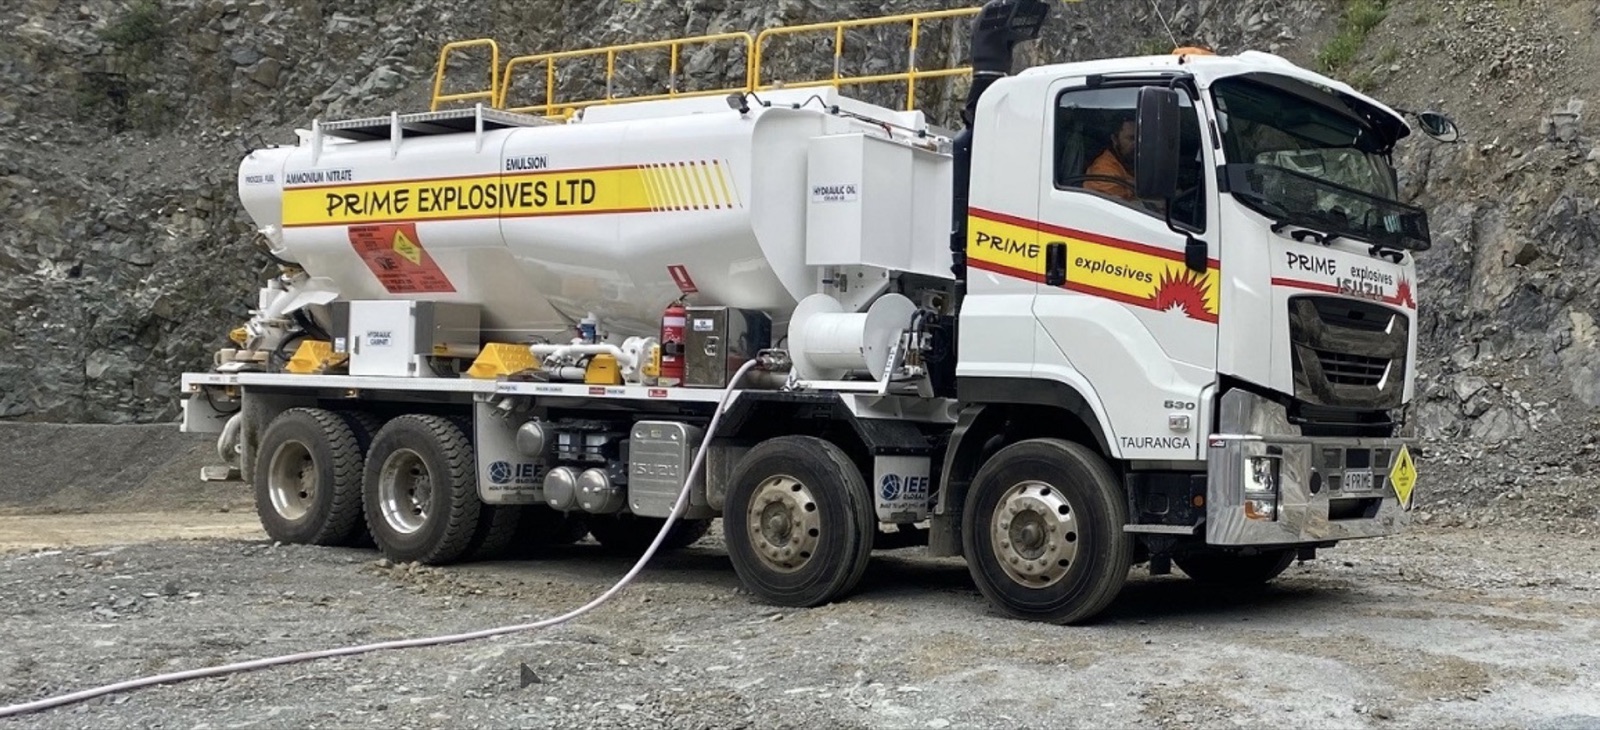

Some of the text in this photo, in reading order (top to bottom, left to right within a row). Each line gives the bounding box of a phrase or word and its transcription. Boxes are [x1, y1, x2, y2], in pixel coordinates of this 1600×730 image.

[505, 156, 547, 171] EMULSION
[285, 169, 352, 185] AMMONIUM NITRATE
[325, 178, 596, 217] PRIME EXPLOSIVES LTD
[813, 185, 856, 196] HYDRAULIC OIL
[975, 231, 1154, 284] PRIME explosives
[1286, 251, 1393, 286] PRIME explosives
[1336, 277, 1384, 301] ISUZU
[367, 331, 392, 339] HYDRAULIC
[1164, 400, 1196, 411] 530
[1120, 437, 1191, 450] TAURANGA
[632, 462, 679, 477] ISUZU
[903, 476, 929, 493] IEE
